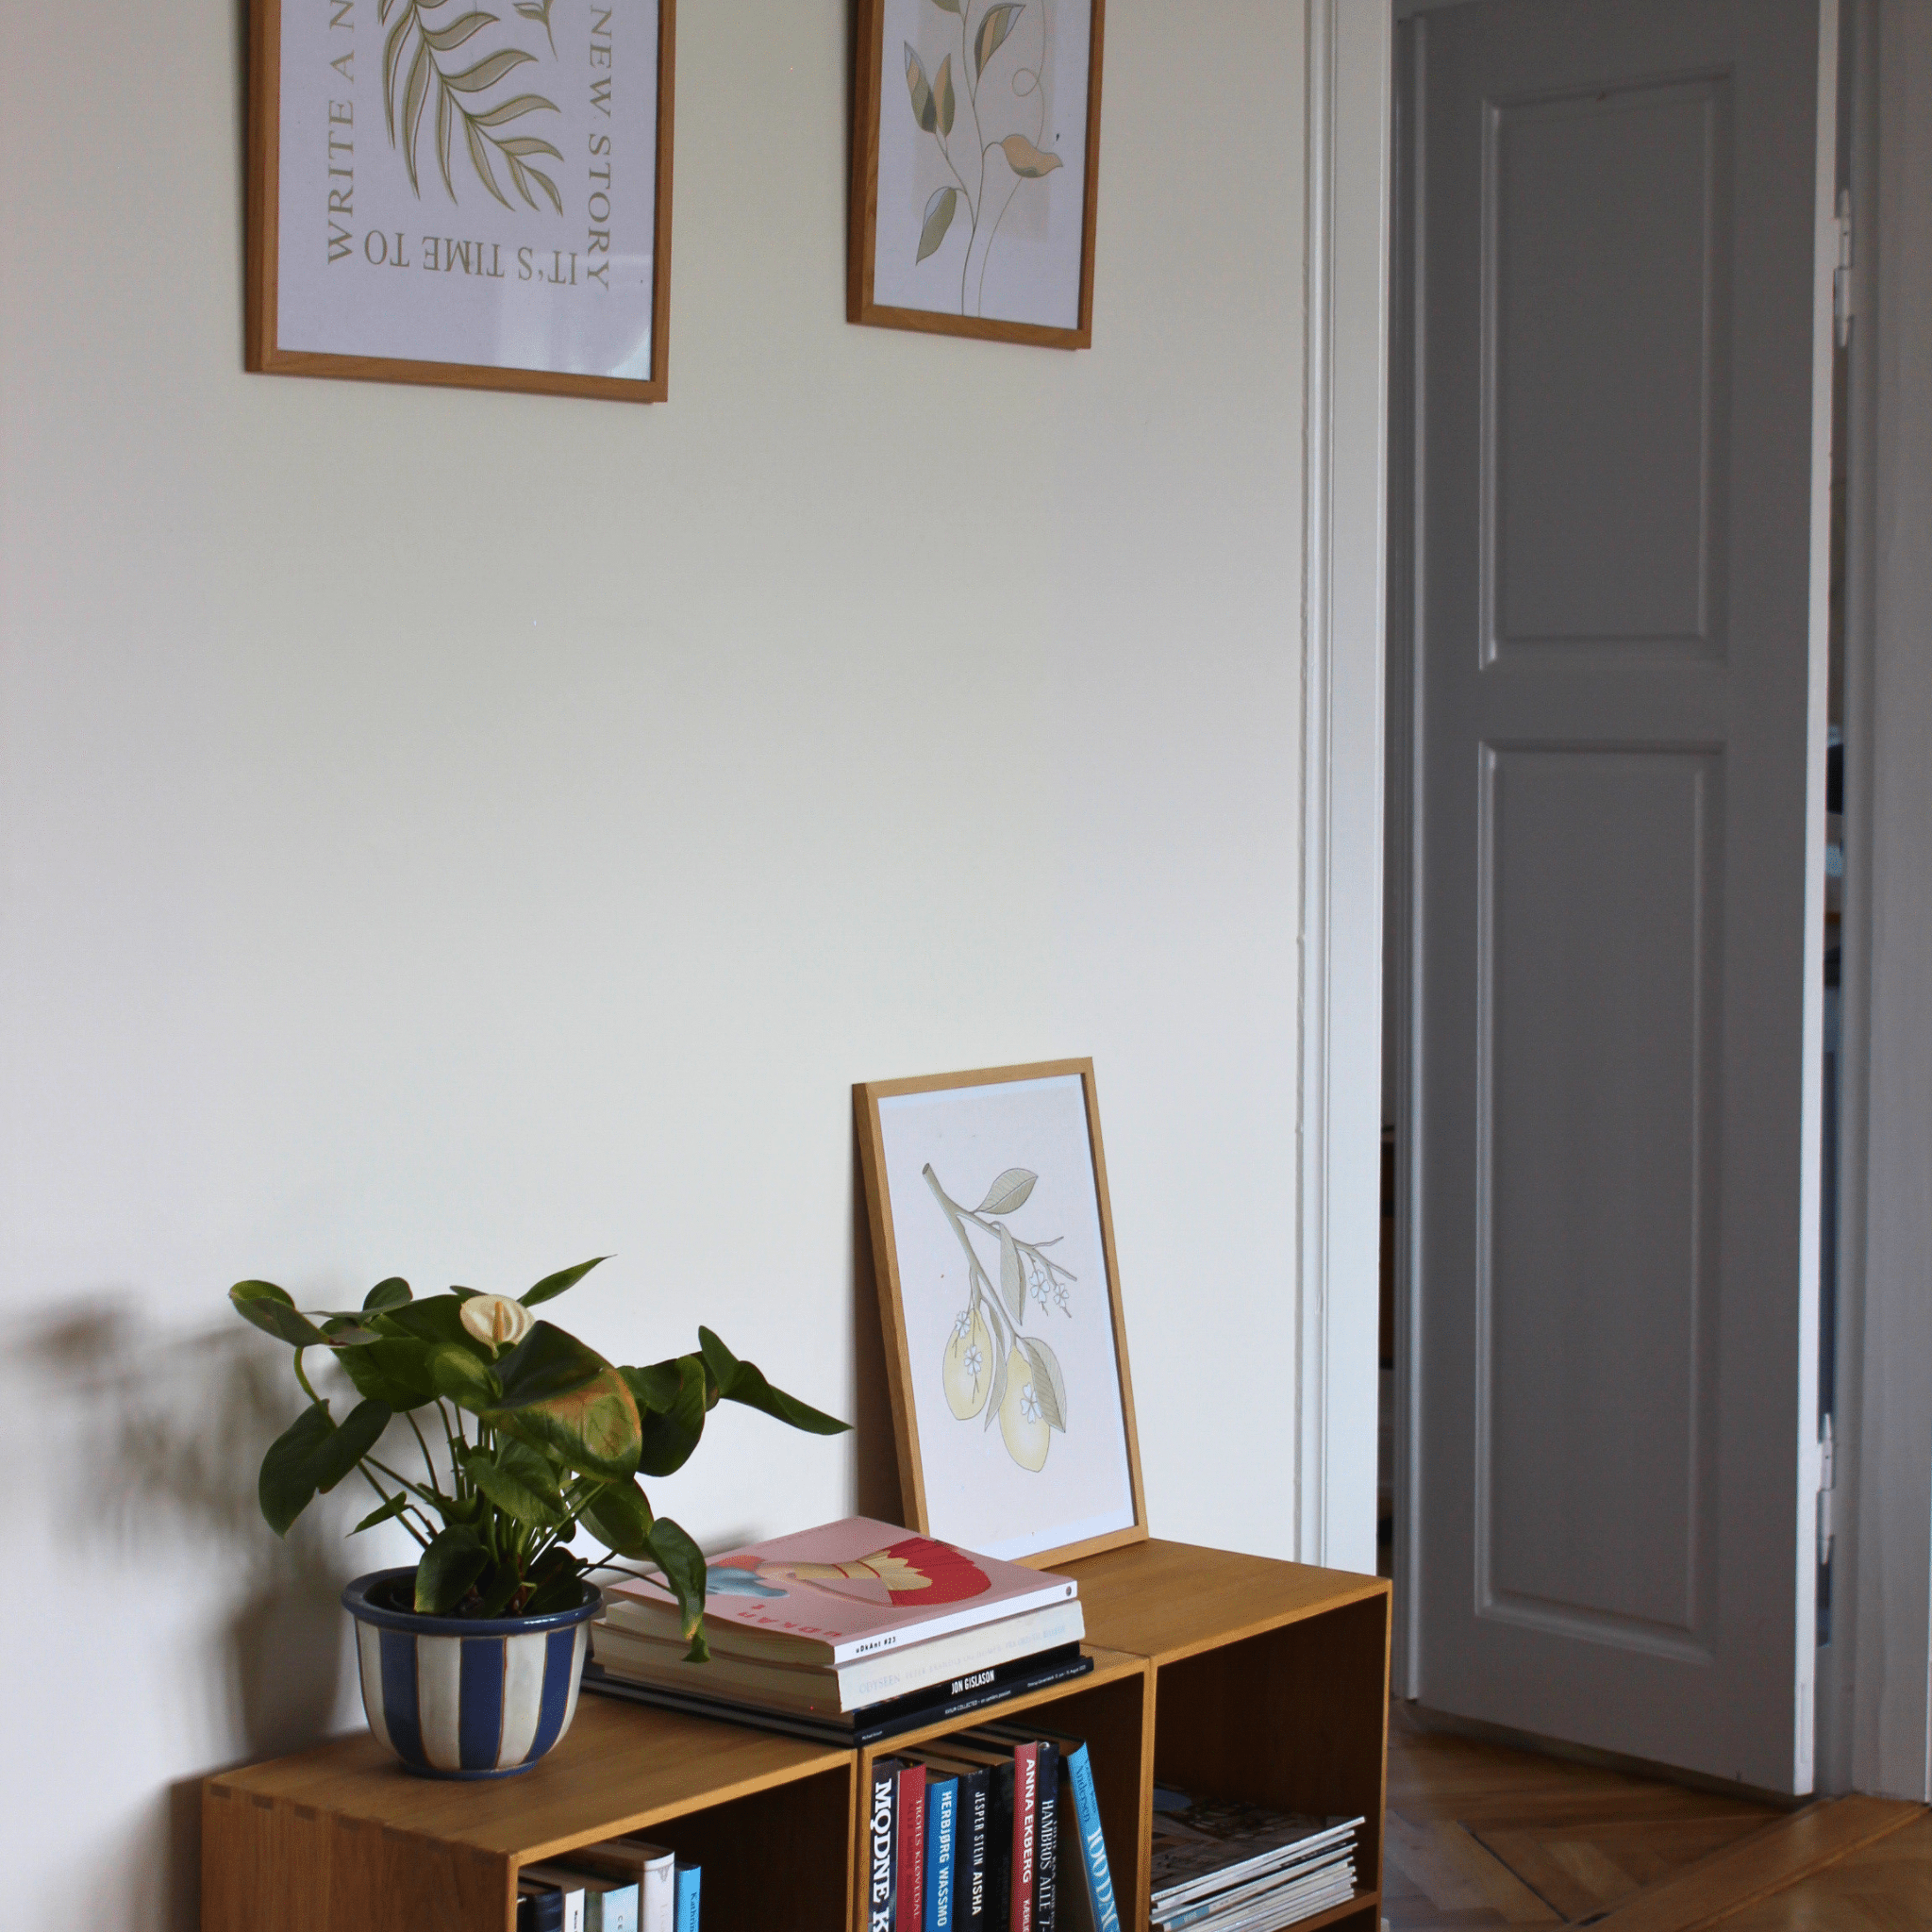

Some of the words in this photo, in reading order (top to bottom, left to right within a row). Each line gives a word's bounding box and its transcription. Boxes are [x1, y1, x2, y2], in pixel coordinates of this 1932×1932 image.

[330, 49, 355, 83] A
[589, 5, 612, 119] NEW
[327, 98, 355, 265] WRITE
[587, 133, 611, 291] STORY
[363, 229, 411, 269] TO
[421, 236, 506, 279] TIME
[516, 246, 578, 286] IT'S
[951, 1680, 963, 1695] JON
[964, 1669, 995, 1690] GISLASON
[1024, 1757, 1036, 1809] ANNA
[914, 1796, 924, 1846] TROELS
[940, 1790, 952, 1864] HERBJØRG
[974, 1791, 986, 1831] JESPER
[1040, 1799, 1055, 1871] HAMBROS
[973, 1834, 984, 1866] STEIN
[1022, 1812, 1035, 1885] EKBERG
[937, 1866, 949, 1927] WASSMO
[972, 1871, 983, 1917] AISHA
